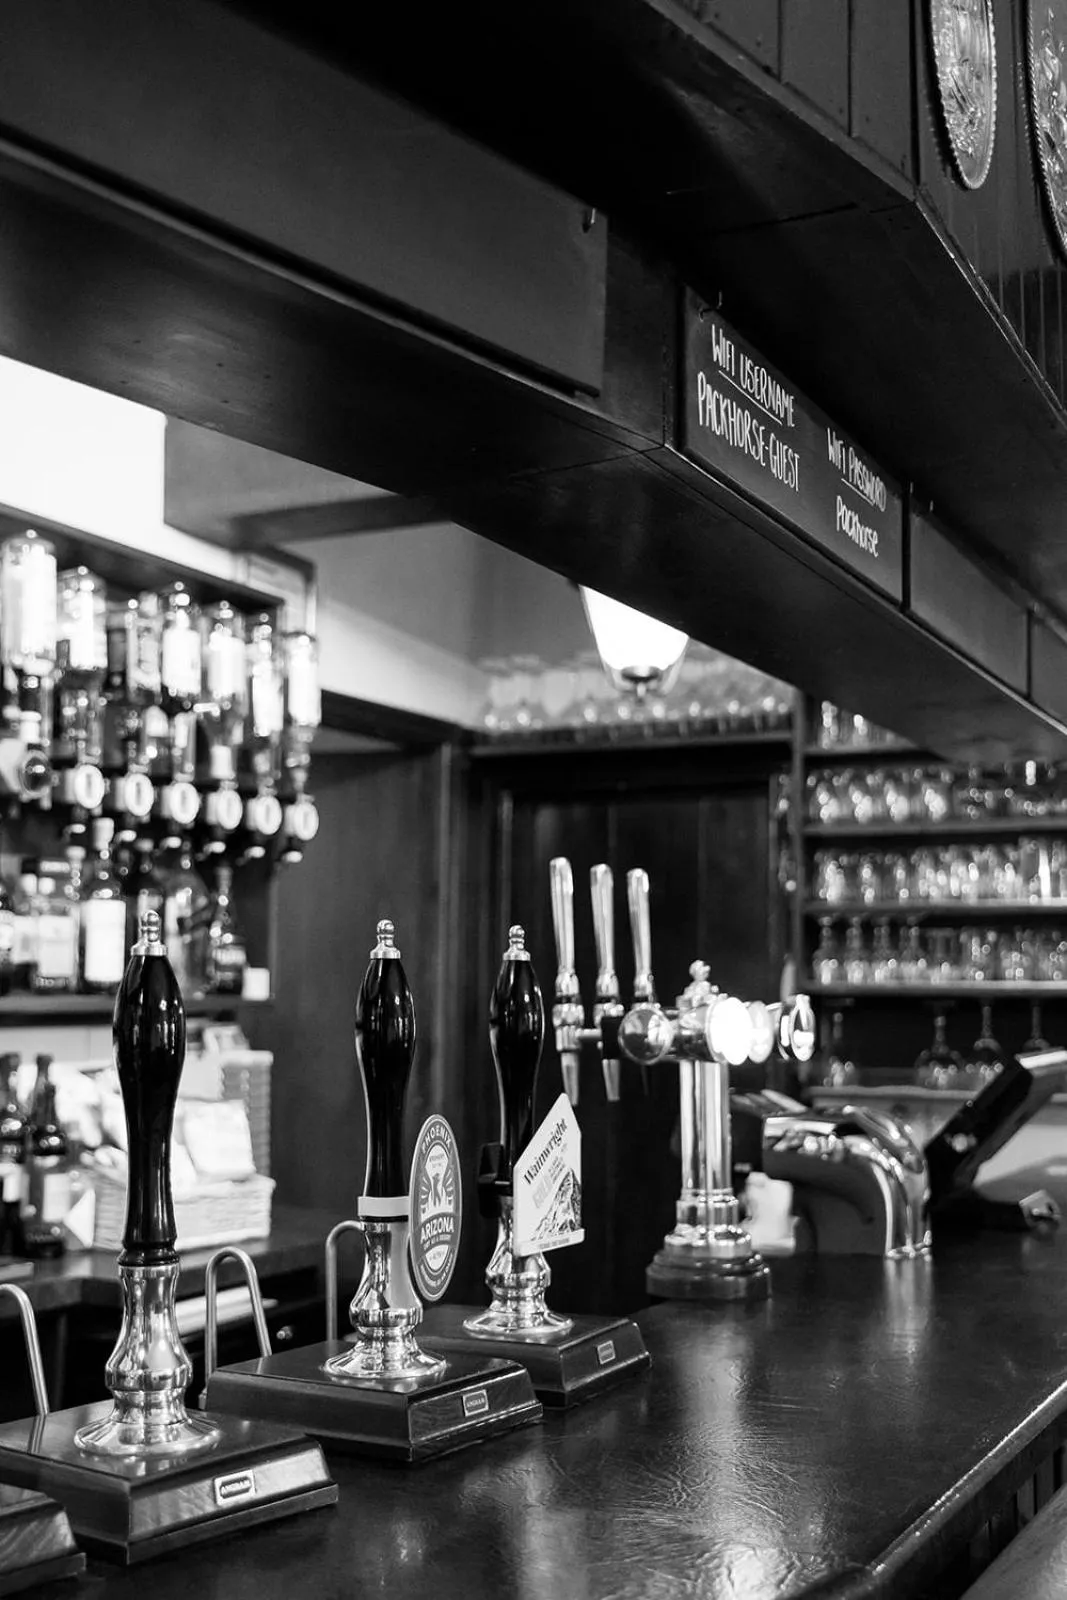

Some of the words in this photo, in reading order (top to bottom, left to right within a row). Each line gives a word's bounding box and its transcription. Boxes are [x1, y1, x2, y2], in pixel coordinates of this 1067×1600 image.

[740, 352, 796, 428] USERNAME
[697, 371, 800, 492] PACKHORSE-GUEST
[422, 1124, 452, 1154] PHOENIX
[523, 1118, 568, 1185] Wainwright
[420, 1216, 455, 1245] ARIZONA
